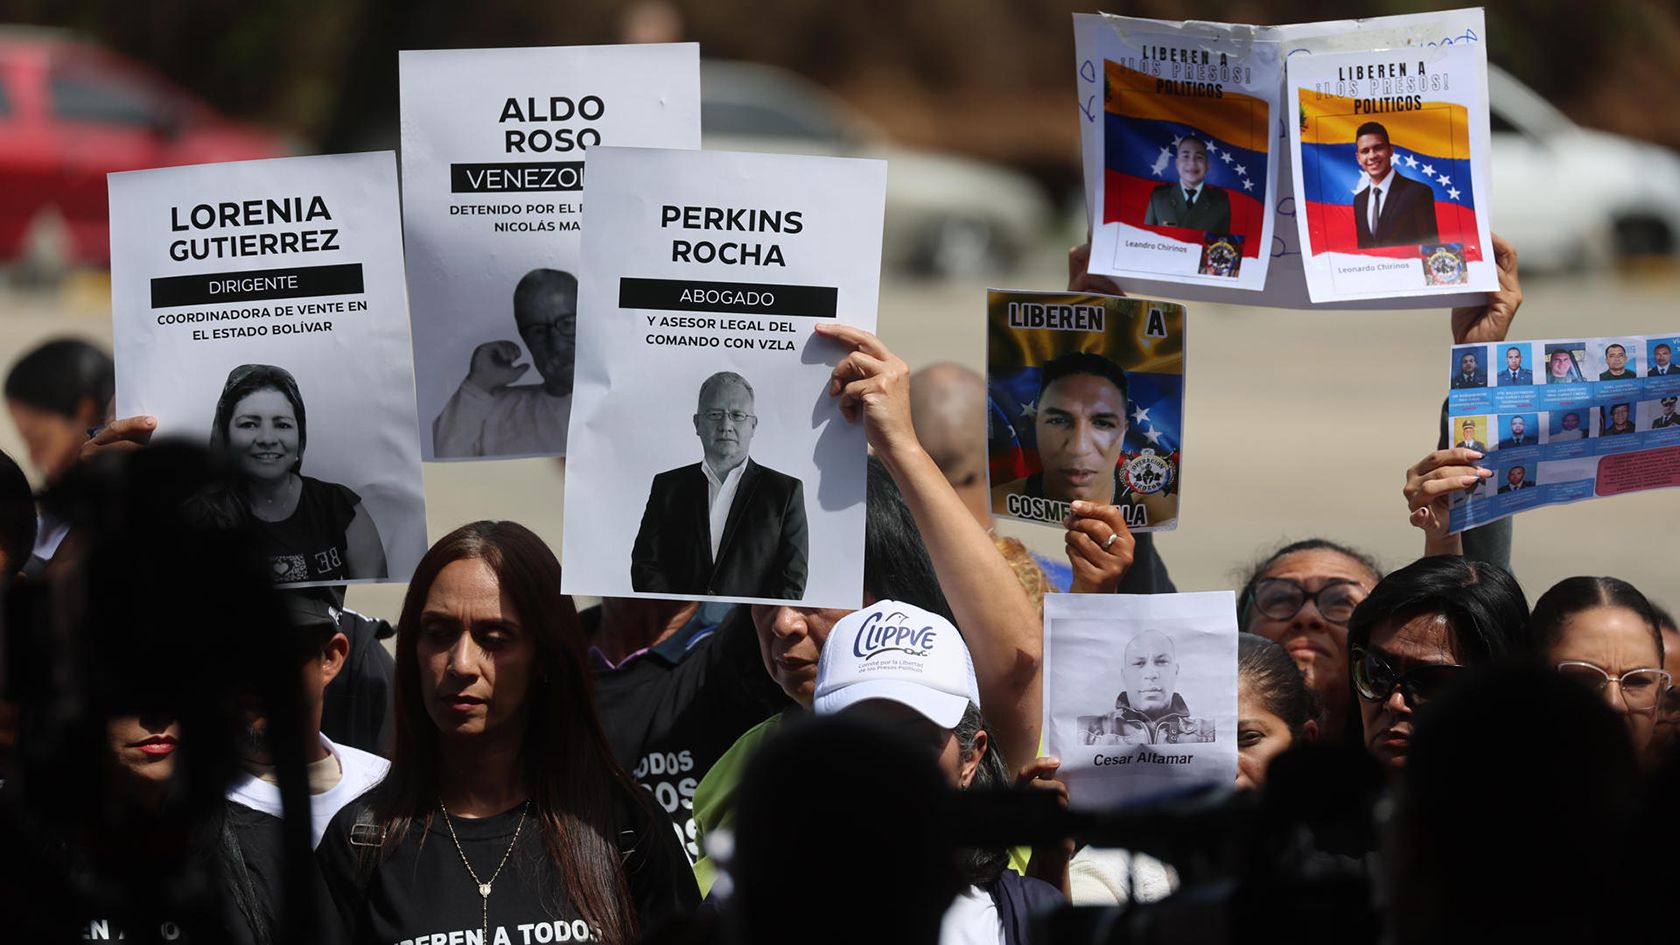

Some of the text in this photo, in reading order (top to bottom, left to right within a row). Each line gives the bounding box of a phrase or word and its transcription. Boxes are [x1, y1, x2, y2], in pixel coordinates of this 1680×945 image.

[1143, 45, 1228, 66] LIBEREN A
[1339, 61, 1426, 81] LIBEREN A
[1156, 79, 1223, 99] POLITICOS
[1370, 73, 1449, 96] PRESOS!
[499, 95, 605, 123] ALDO
[1354, 95, 1422, 114] POLITICOS
[505, 128, 601, 153] ROSO
[171, 196, 332, 232] LORENIA
[450, 204, 522, 215] DETENIDO
[526, 204, 554, 214] POR
[559, 204, 576, 214] EL
[661, 204, 804, 234] PERKINS
[494, 220, 555, 232] NICOLÁS
[169, 229, 340, 262] GUTIERREZ
[672, 240, 786, 267] ROCHA
[1125, 240, 1188, 252] Leandro Chirinos
[1338, 262, 1410, 274] Leonardo Chirinos
[209, 275, 298, 295] DIRIGENTE
[679, 288, 775, 307] ABOGADO
[157, 300, 368, 325] COORDINADORA DE VENTE EN
[1010, 302, 1167, 338] LIBEREN A
[192, 321, 333, 340] EL ESTADO BOLÍVAR
[647, 316, 796, 332] Y ASESOR LEGAL DEL
[646, 334, 796, 350] COMANDO CON VZLA
[1116, 504, 1148, 527] LA
[633, 750, 694, 778] ODOS
[1094, 752, 1194, 766] Cesar Altamar
[517, 919, 602, 945] TODO
